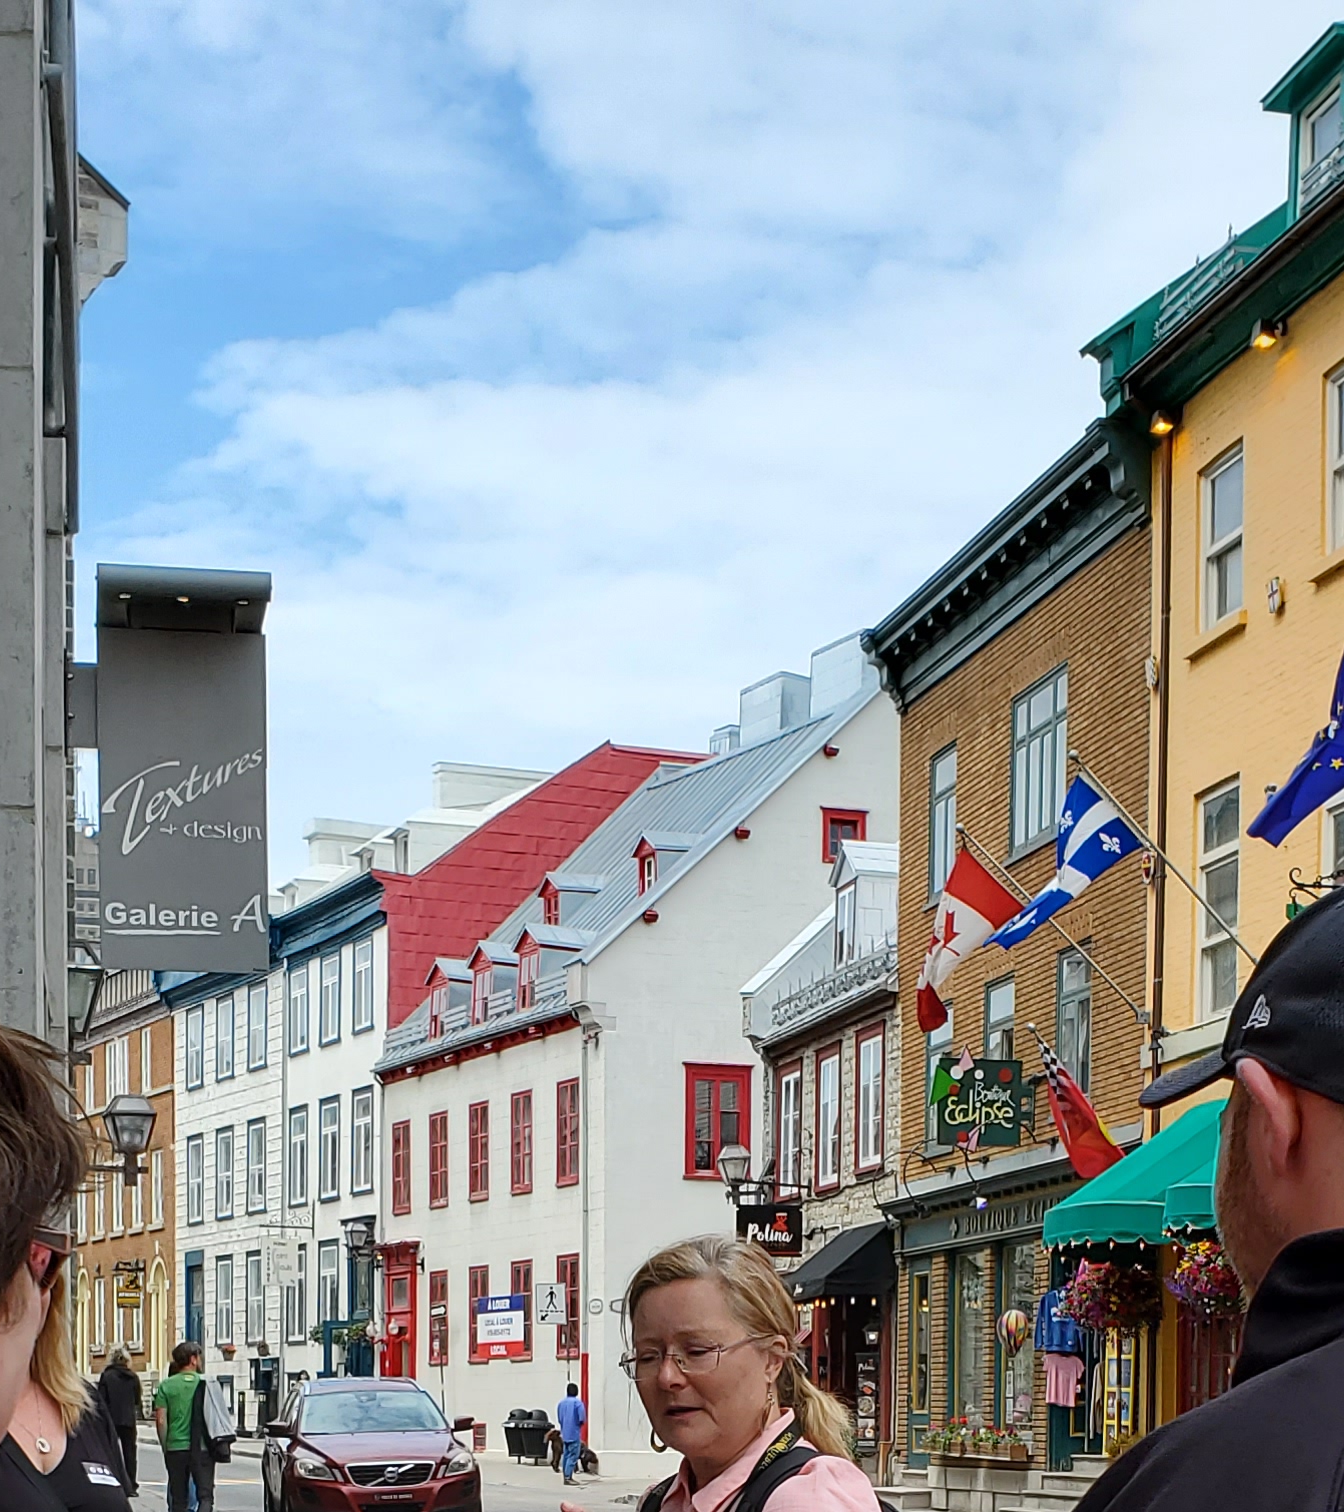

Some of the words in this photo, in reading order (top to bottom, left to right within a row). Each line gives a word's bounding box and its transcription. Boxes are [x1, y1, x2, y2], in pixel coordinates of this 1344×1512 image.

[101, 747, 264, 855] Textures
[183, 820, 263, 843] design
[105, 902, 219, 929] Galerie
[230, 895, 266, 934] A
[963, 1205, 1019, 1235] BOUTIQUE
